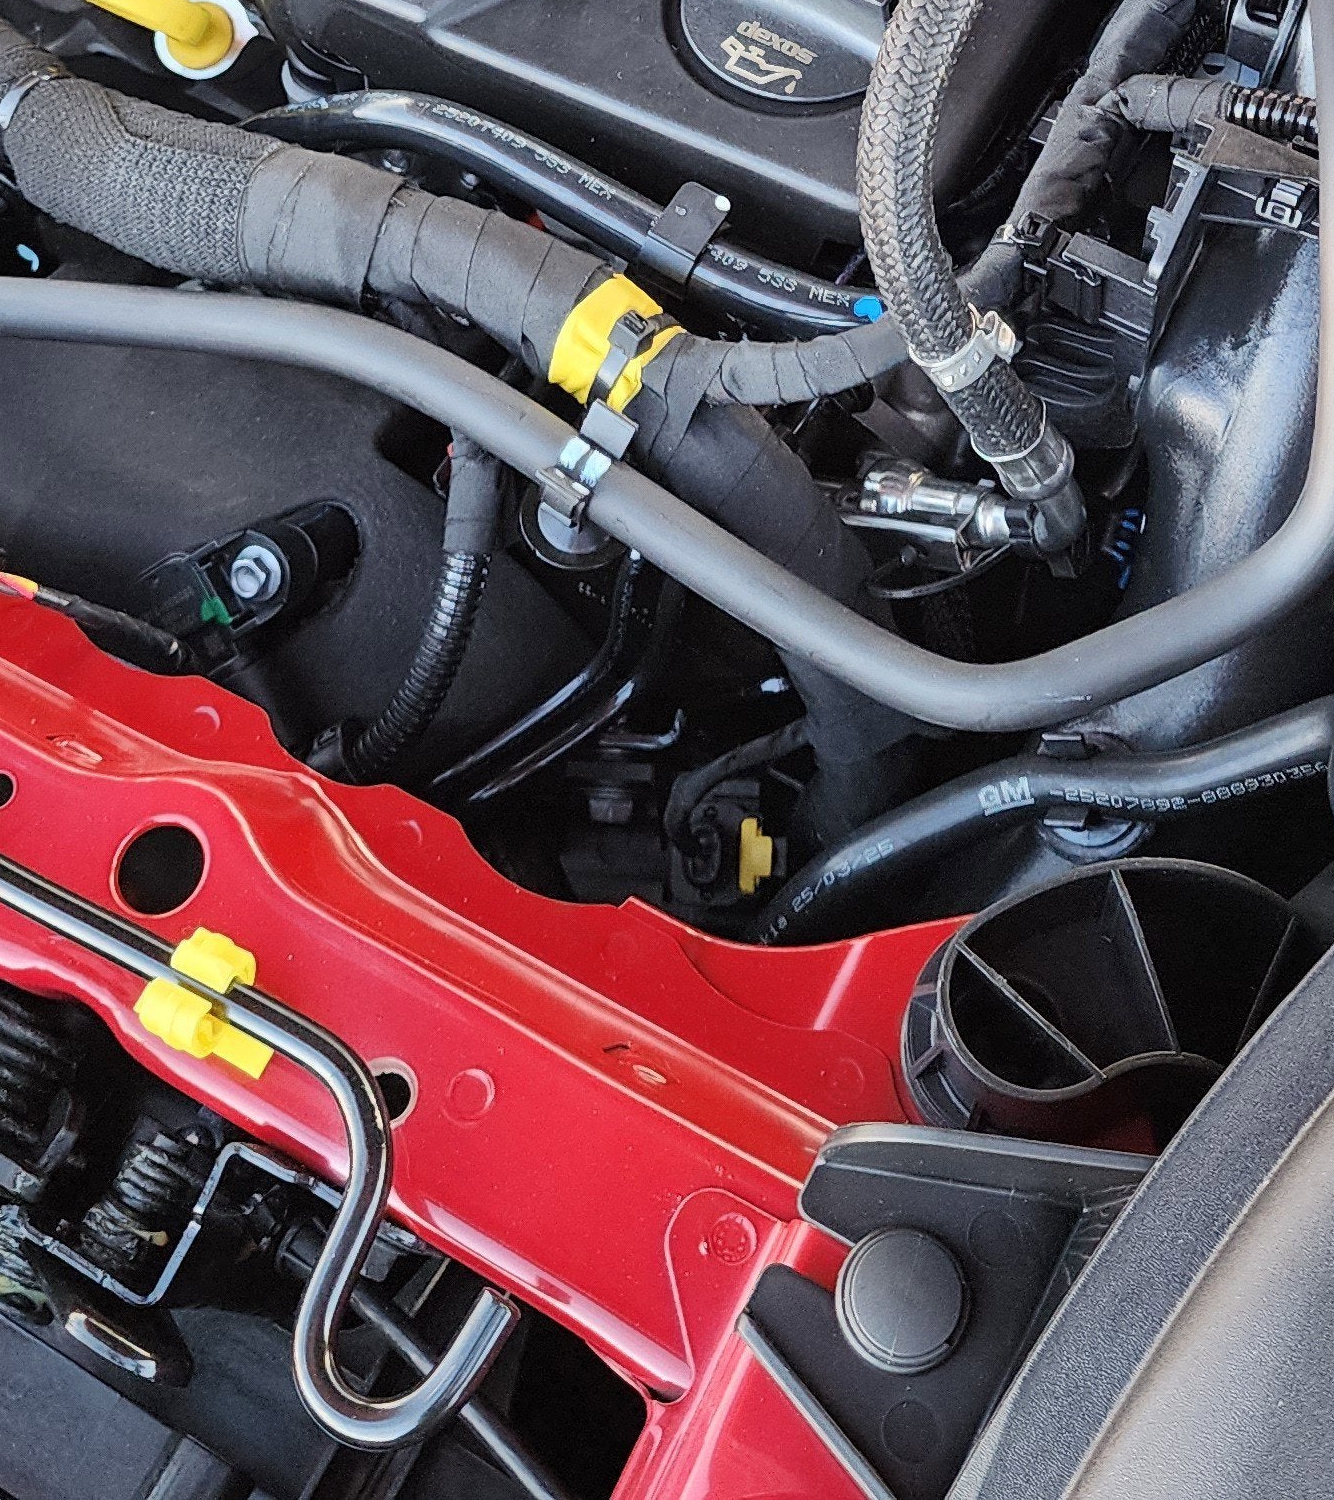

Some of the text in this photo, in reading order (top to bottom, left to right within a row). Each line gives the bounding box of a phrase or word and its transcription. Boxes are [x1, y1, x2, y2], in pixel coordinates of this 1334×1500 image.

[736, 20, 819, 65] dexos
[577, 171, 617, 201] MEX
[978, 776, 1035, 816] GM
